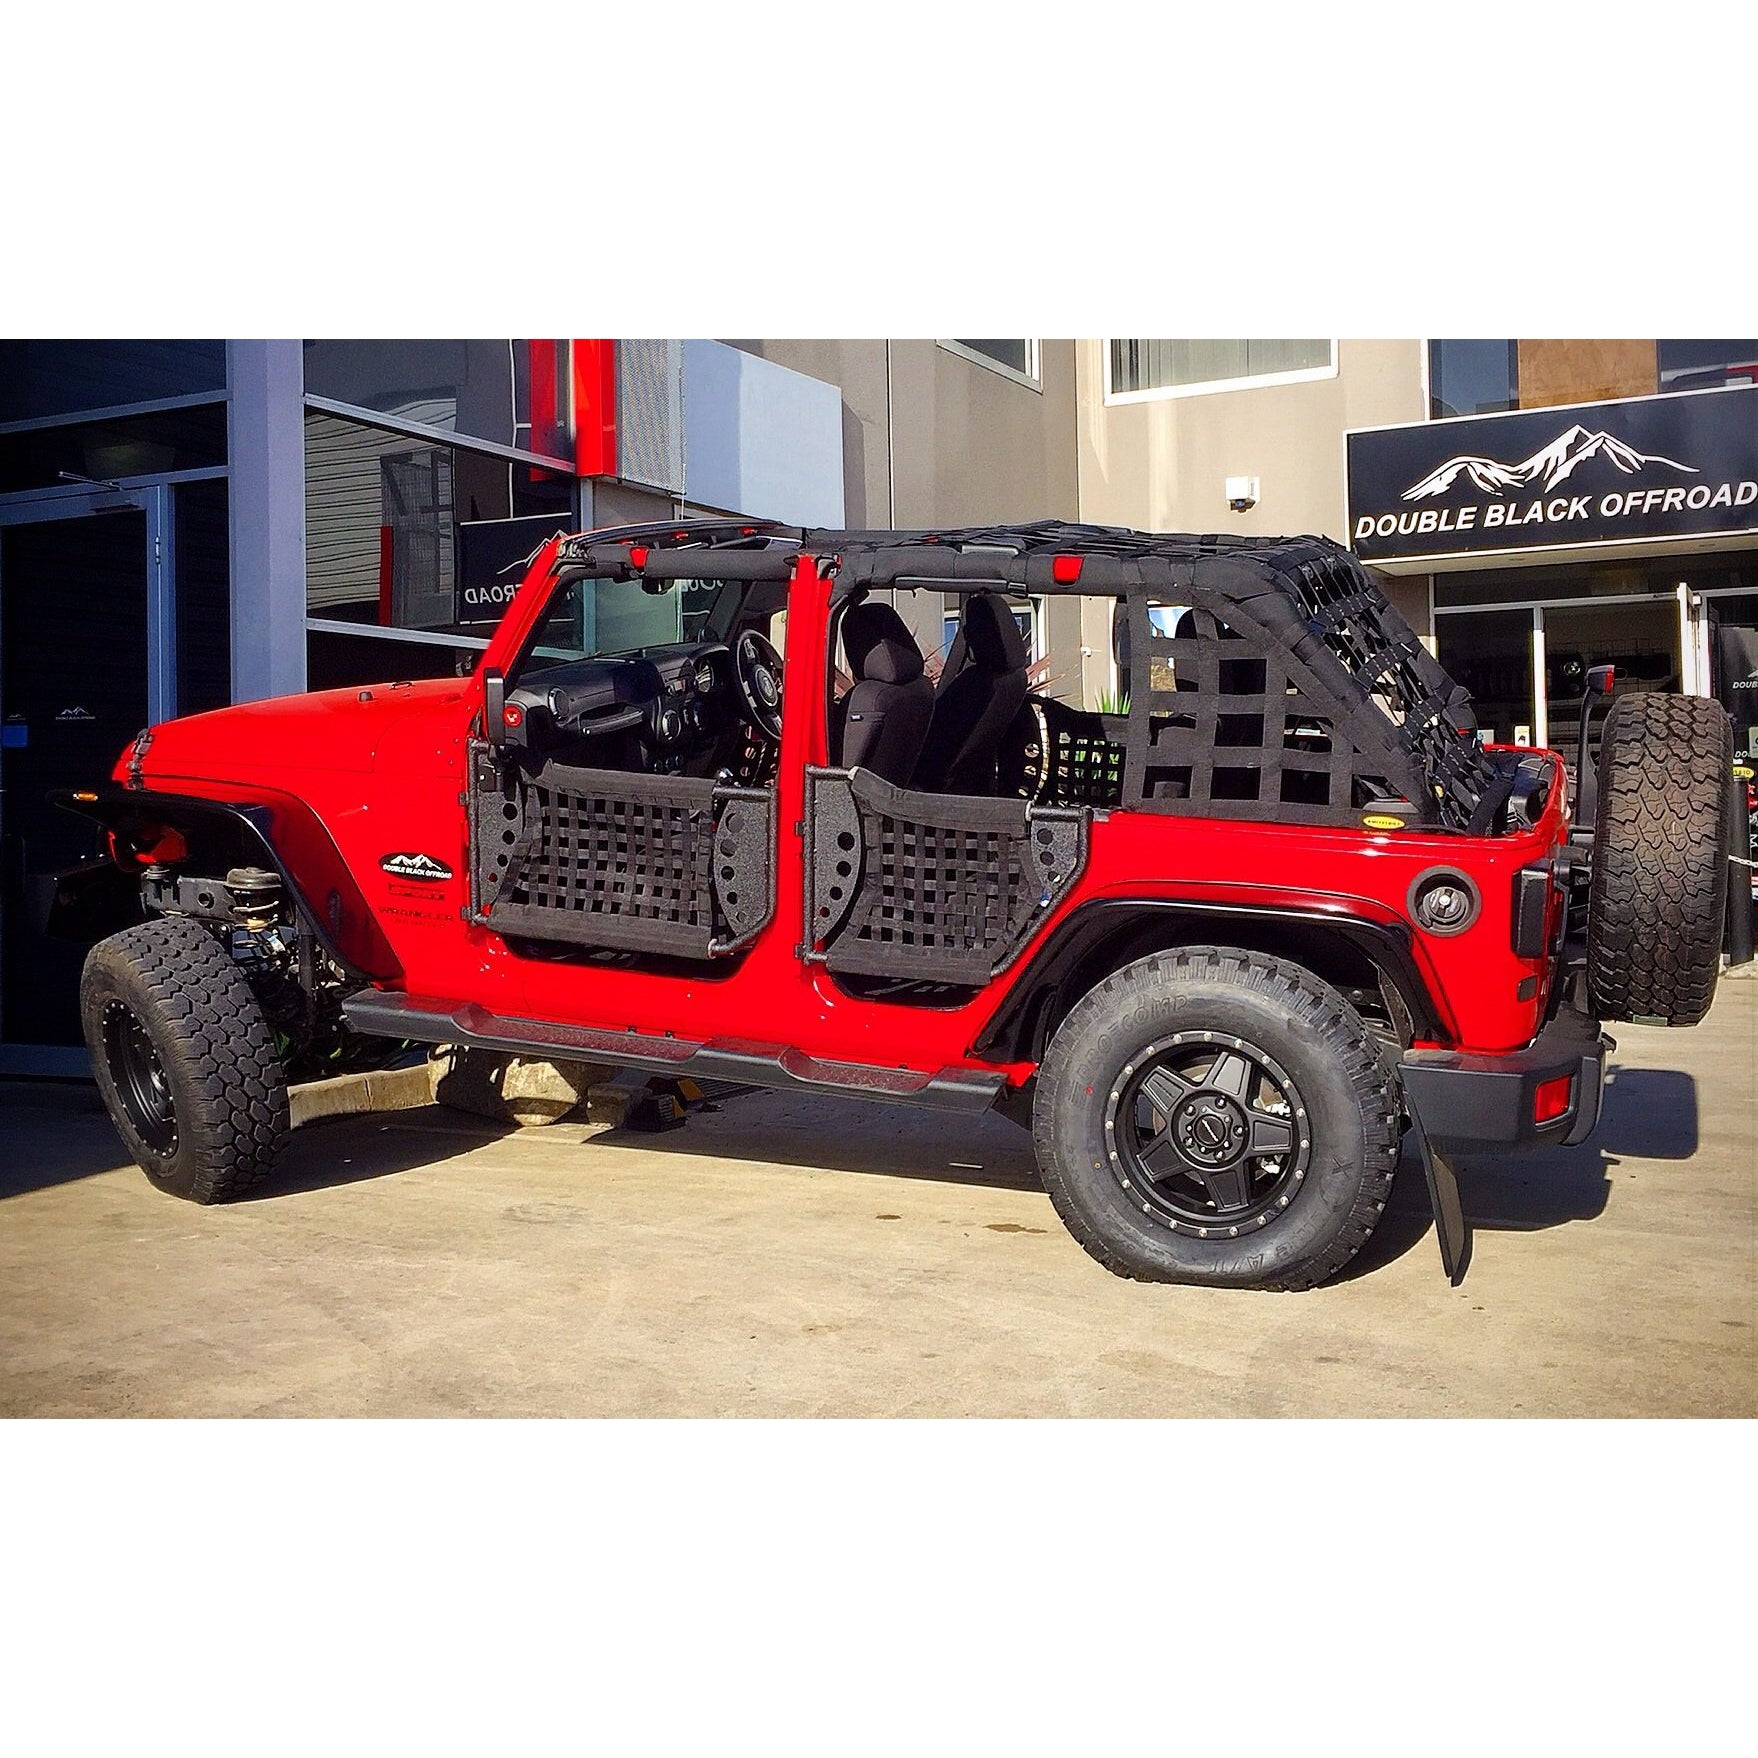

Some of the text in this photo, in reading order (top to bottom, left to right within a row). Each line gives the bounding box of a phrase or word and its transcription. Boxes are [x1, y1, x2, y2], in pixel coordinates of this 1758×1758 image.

[1354, 481, 1758, 539] DOUBLE BLACK OFFROAD
[383, 864, 452, 879] DOUBLE BLACK OFFROAD
